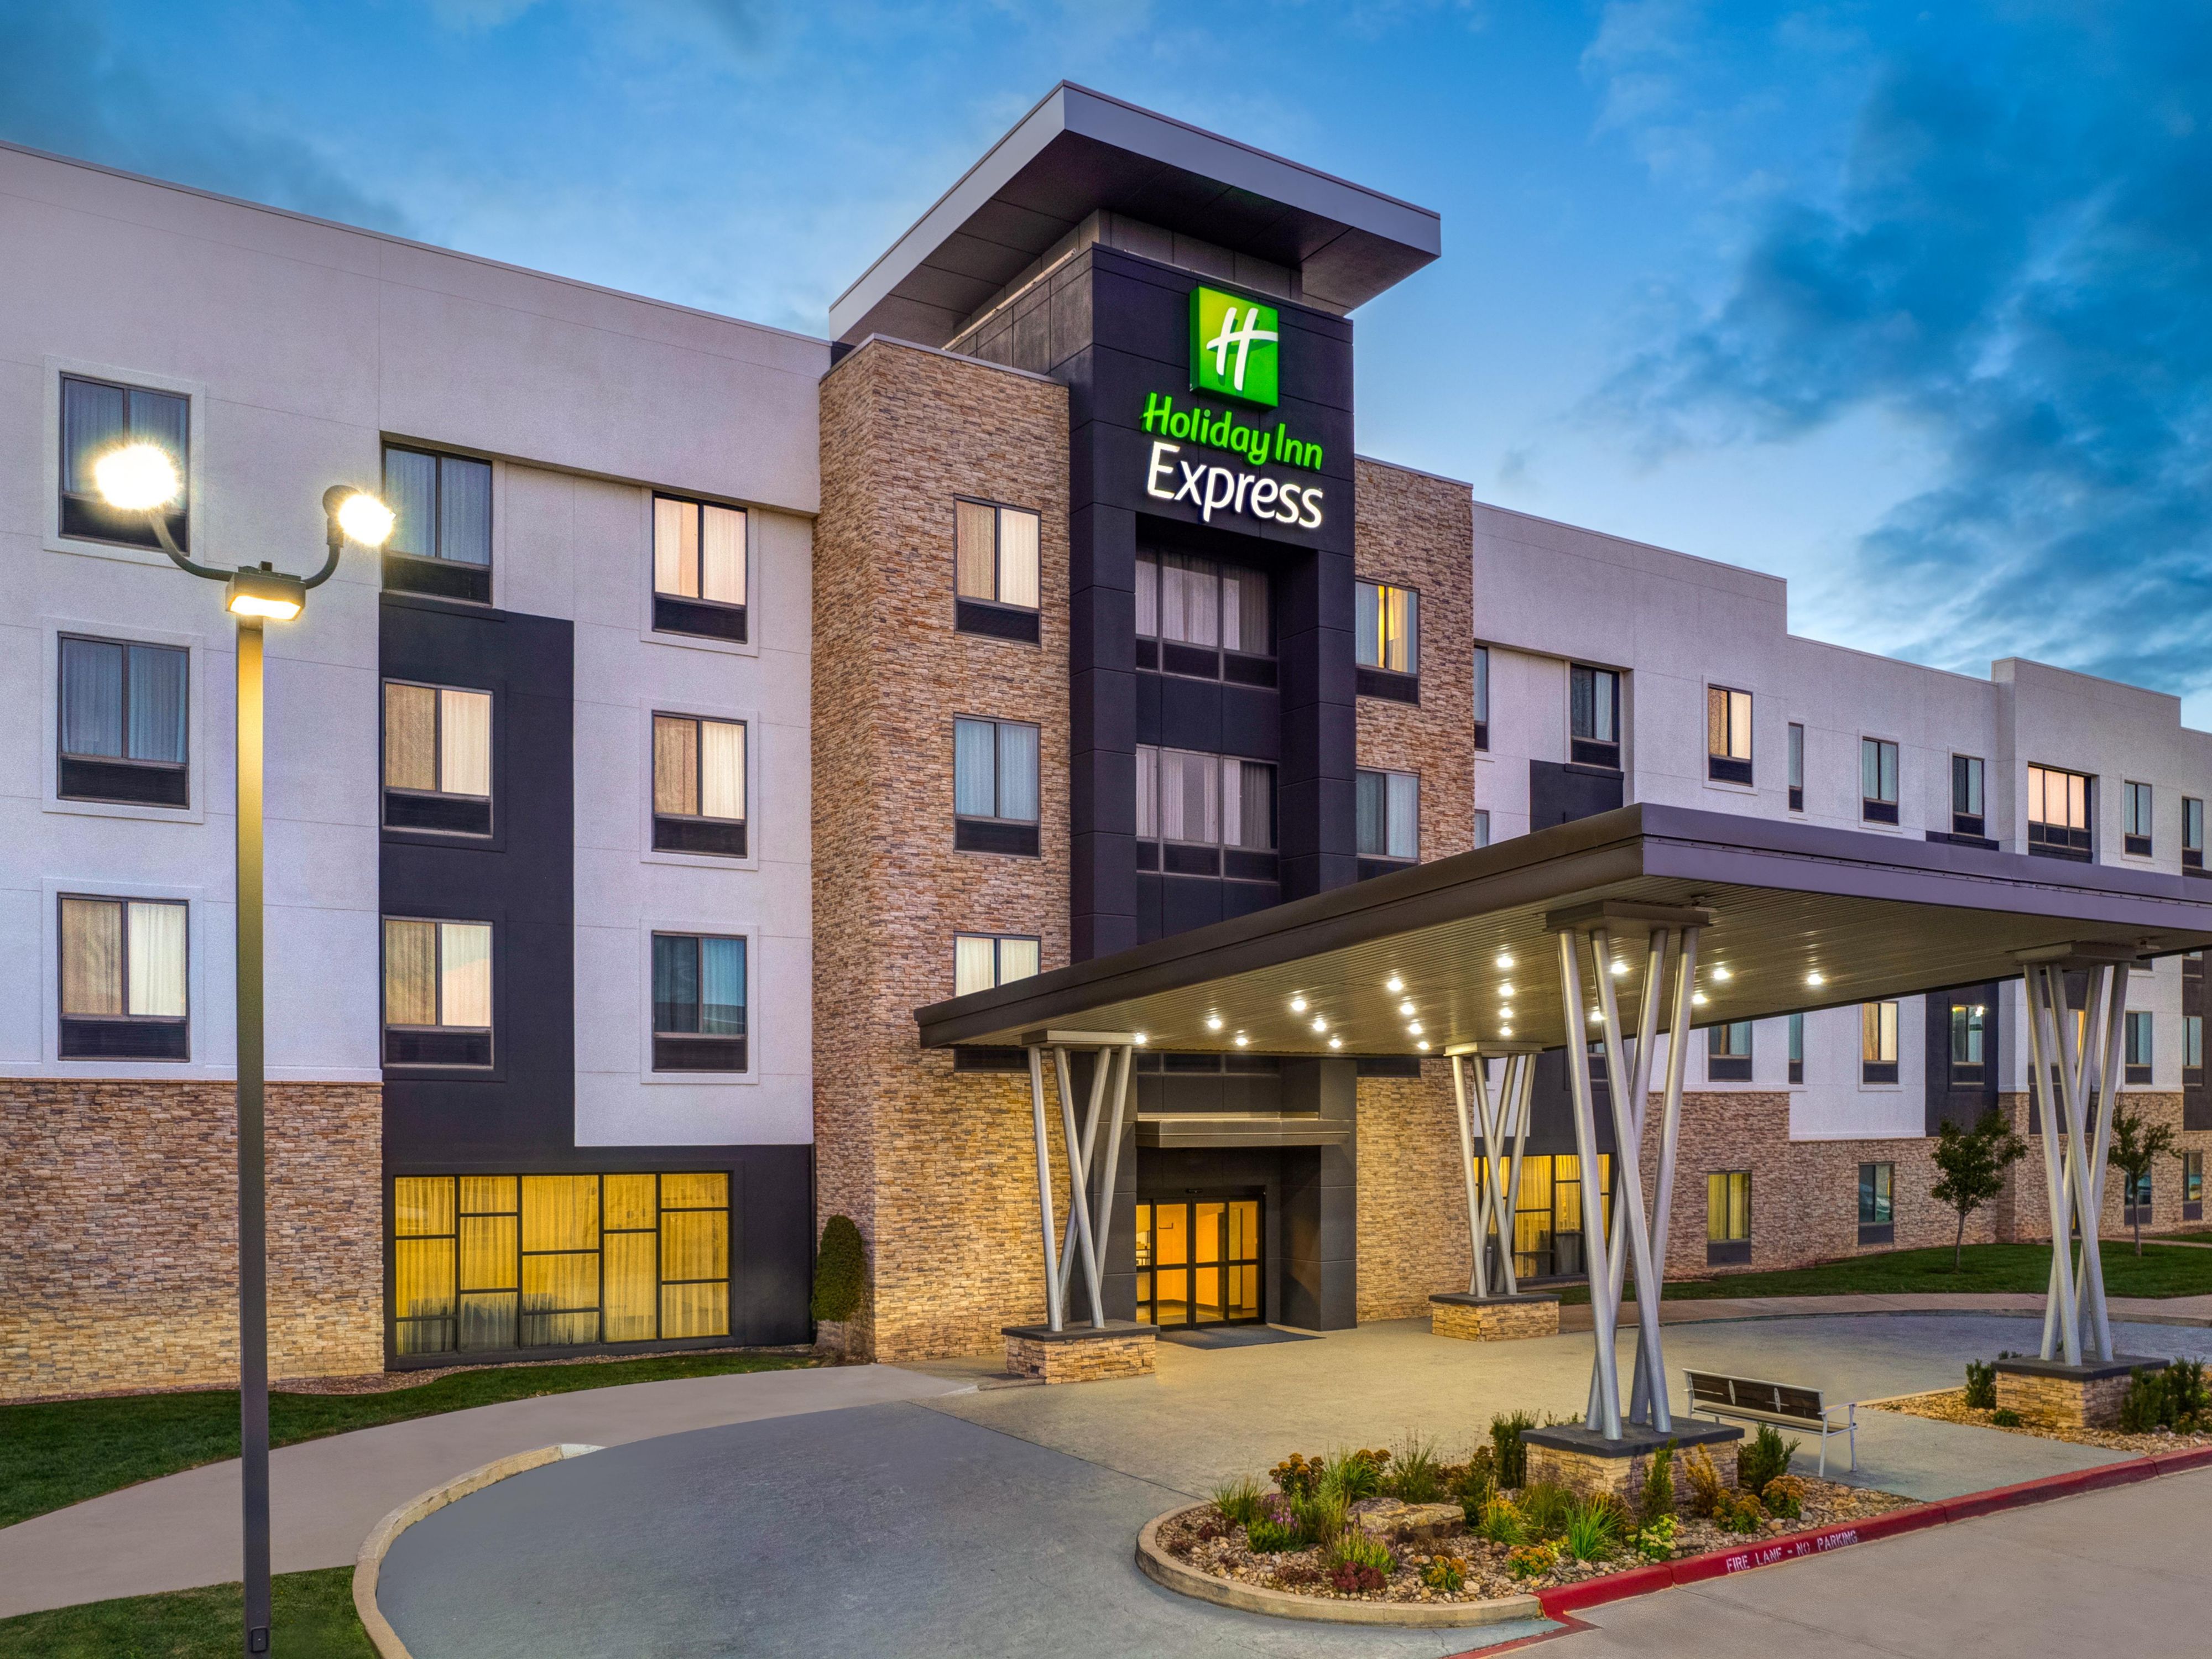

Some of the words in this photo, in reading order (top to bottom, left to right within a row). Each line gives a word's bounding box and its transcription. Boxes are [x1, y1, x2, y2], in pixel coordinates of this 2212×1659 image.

[1206, 307, 1279, 392] H
[1141, 392, 1270, 466] Holiday
[1275, 423, 1323, 470] Inn
[1147, 441, 1323, 528] Express
[1726, 1555, 1750, 1573] FIRE
[1796, 1542, 1810, 1556] NO
[1817, 1530, 1858, 1551] PARKING
